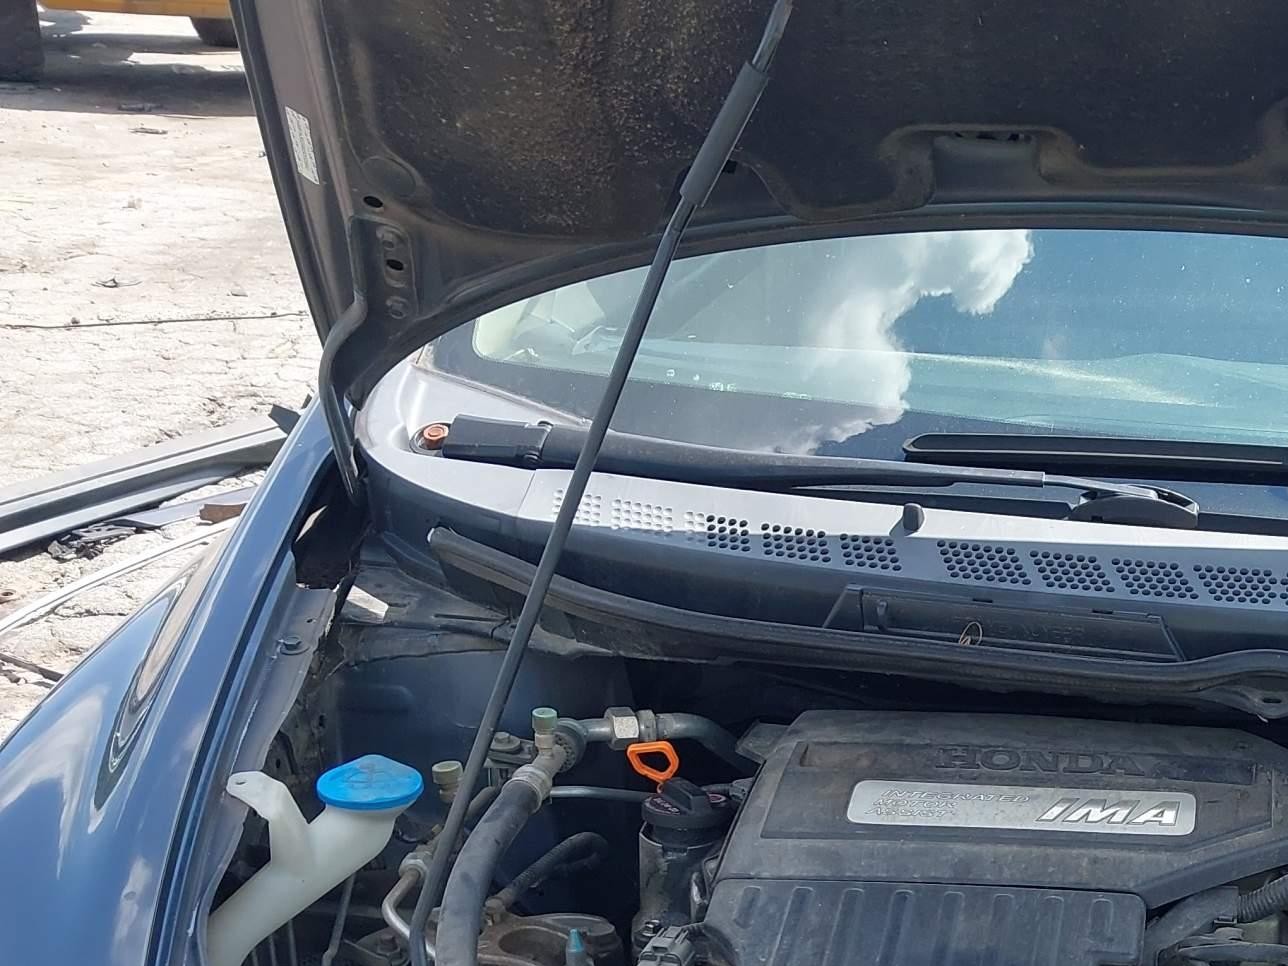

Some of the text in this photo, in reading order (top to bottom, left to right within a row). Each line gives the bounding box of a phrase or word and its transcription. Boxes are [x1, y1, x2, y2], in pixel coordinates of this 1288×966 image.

[935, 747, 1145, 777] HONDA
[881, 789, 1031, 803] INTEGRATED
[872, 799, 959, 809] MOTOR
[864, 807, 953, 818] ASSIST
[1036, 797, 1181, 827] IMA
